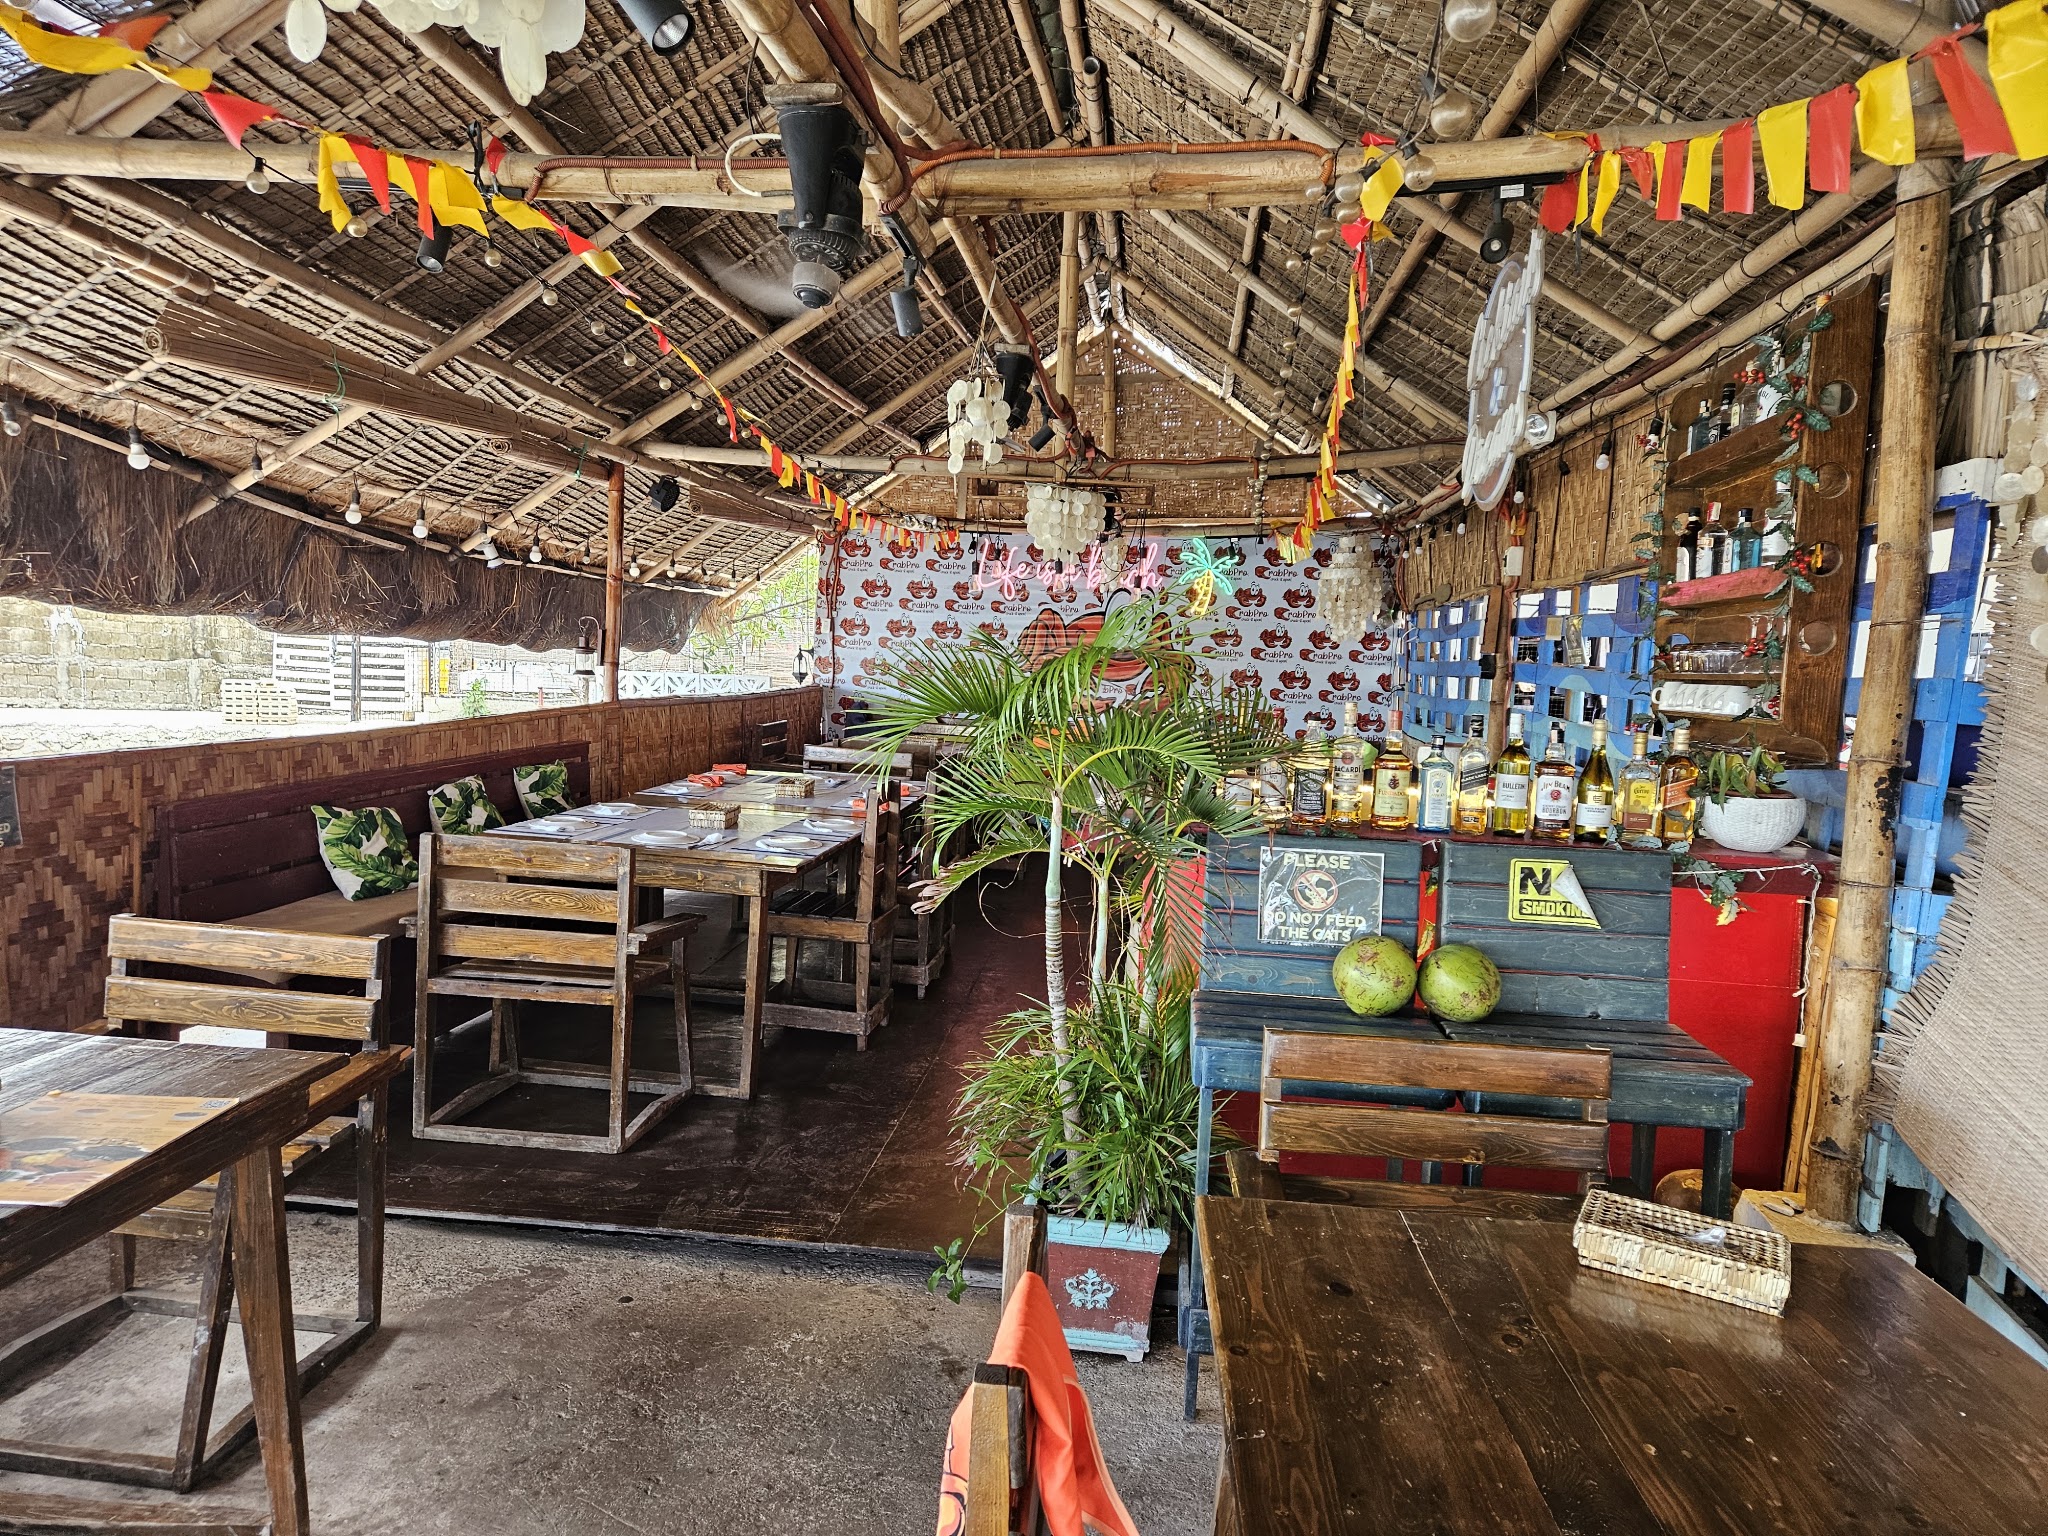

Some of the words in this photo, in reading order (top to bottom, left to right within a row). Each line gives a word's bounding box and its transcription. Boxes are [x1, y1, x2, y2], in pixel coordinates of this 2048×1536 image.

[1283, 853, 1351, 870] PLEASE
[1520, 867, 1564, 896] N
[1290, 912, 1322, 924] NOT
[1326, 913, 1366, 928] FEED
[1278, 926, 1309, 939] THE
[1312, 928, 1351, 941] CATS
